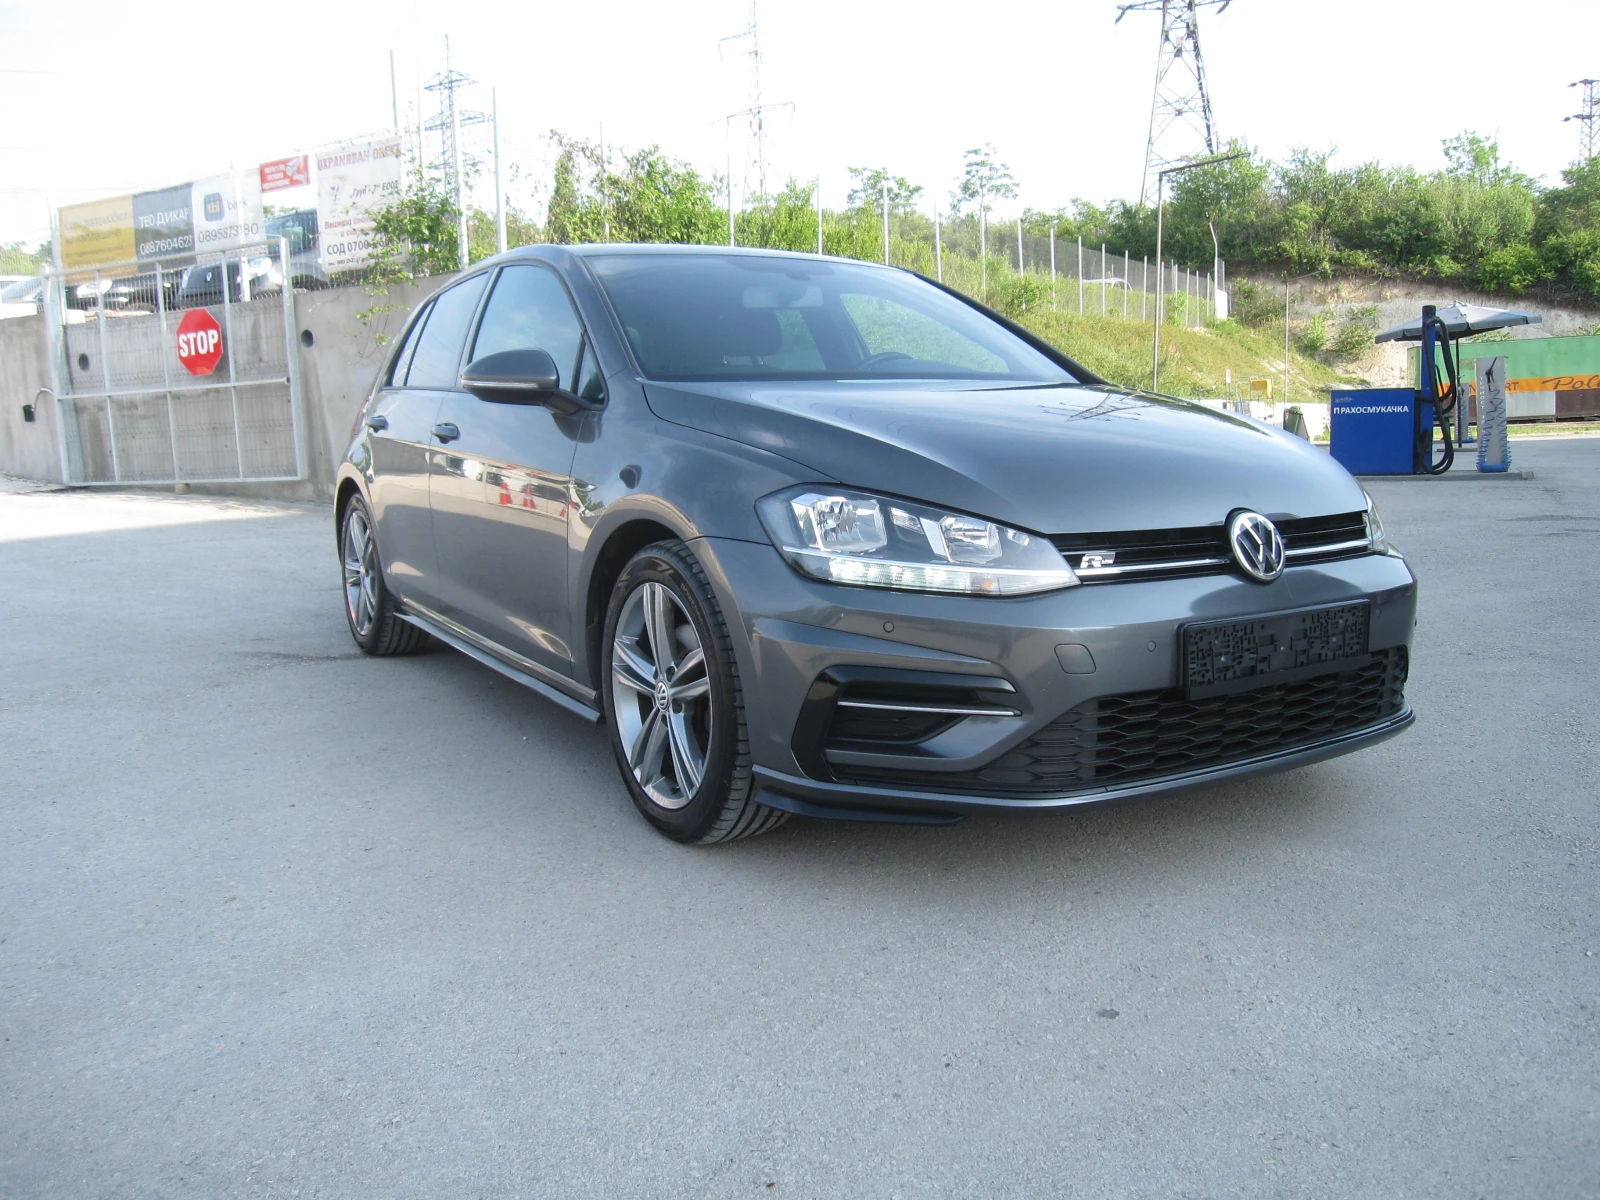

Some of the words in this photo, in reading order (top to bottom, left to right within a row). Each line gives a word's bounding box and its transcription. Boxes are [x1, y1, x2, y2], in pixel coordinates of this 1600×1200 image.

[227, 197, 247, 211] bak
[178, 329, 219, 358] STOP
[1333, 405, 1409, 415] ПРАХОСМУКАЧКА
